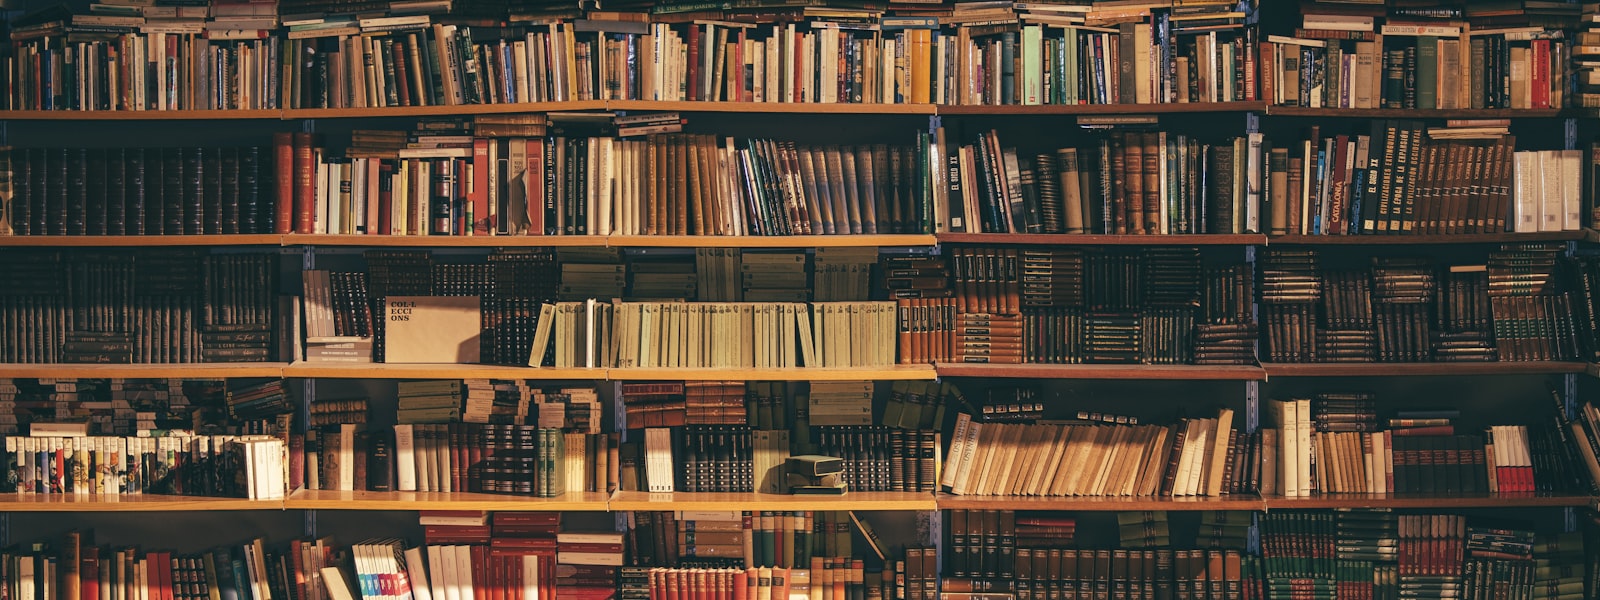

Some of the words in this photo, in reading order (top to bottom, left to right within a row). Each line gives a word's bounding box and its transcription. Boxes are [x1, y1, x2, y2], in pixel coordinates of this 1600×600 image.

[950, 156, 958, 164] XX
[1370, 158, 1379, 167] XX
[1384, 127, 1396, 166] EXTINGUIDAS
[1411, 129, 1422, 165] OCCIDENTAL
[950, 168, 958, 182] SIGLO
[1369, 170, 1377, 185] SIGLO
[1393, 186, 1403, 205] ÉPOCA
[1398, 130, 1409, 163] EXPANSIÓN
[1332, 181, 1342, 223] CATALONIA
[1380, 168, 1392, 214] CIVILIZACIONES
[1406, 167, 1417, 205] CIVILIZACIÓN
[952, 419, 967, 453] PARNASO
[963, 428, 977, 461] PARNASO
